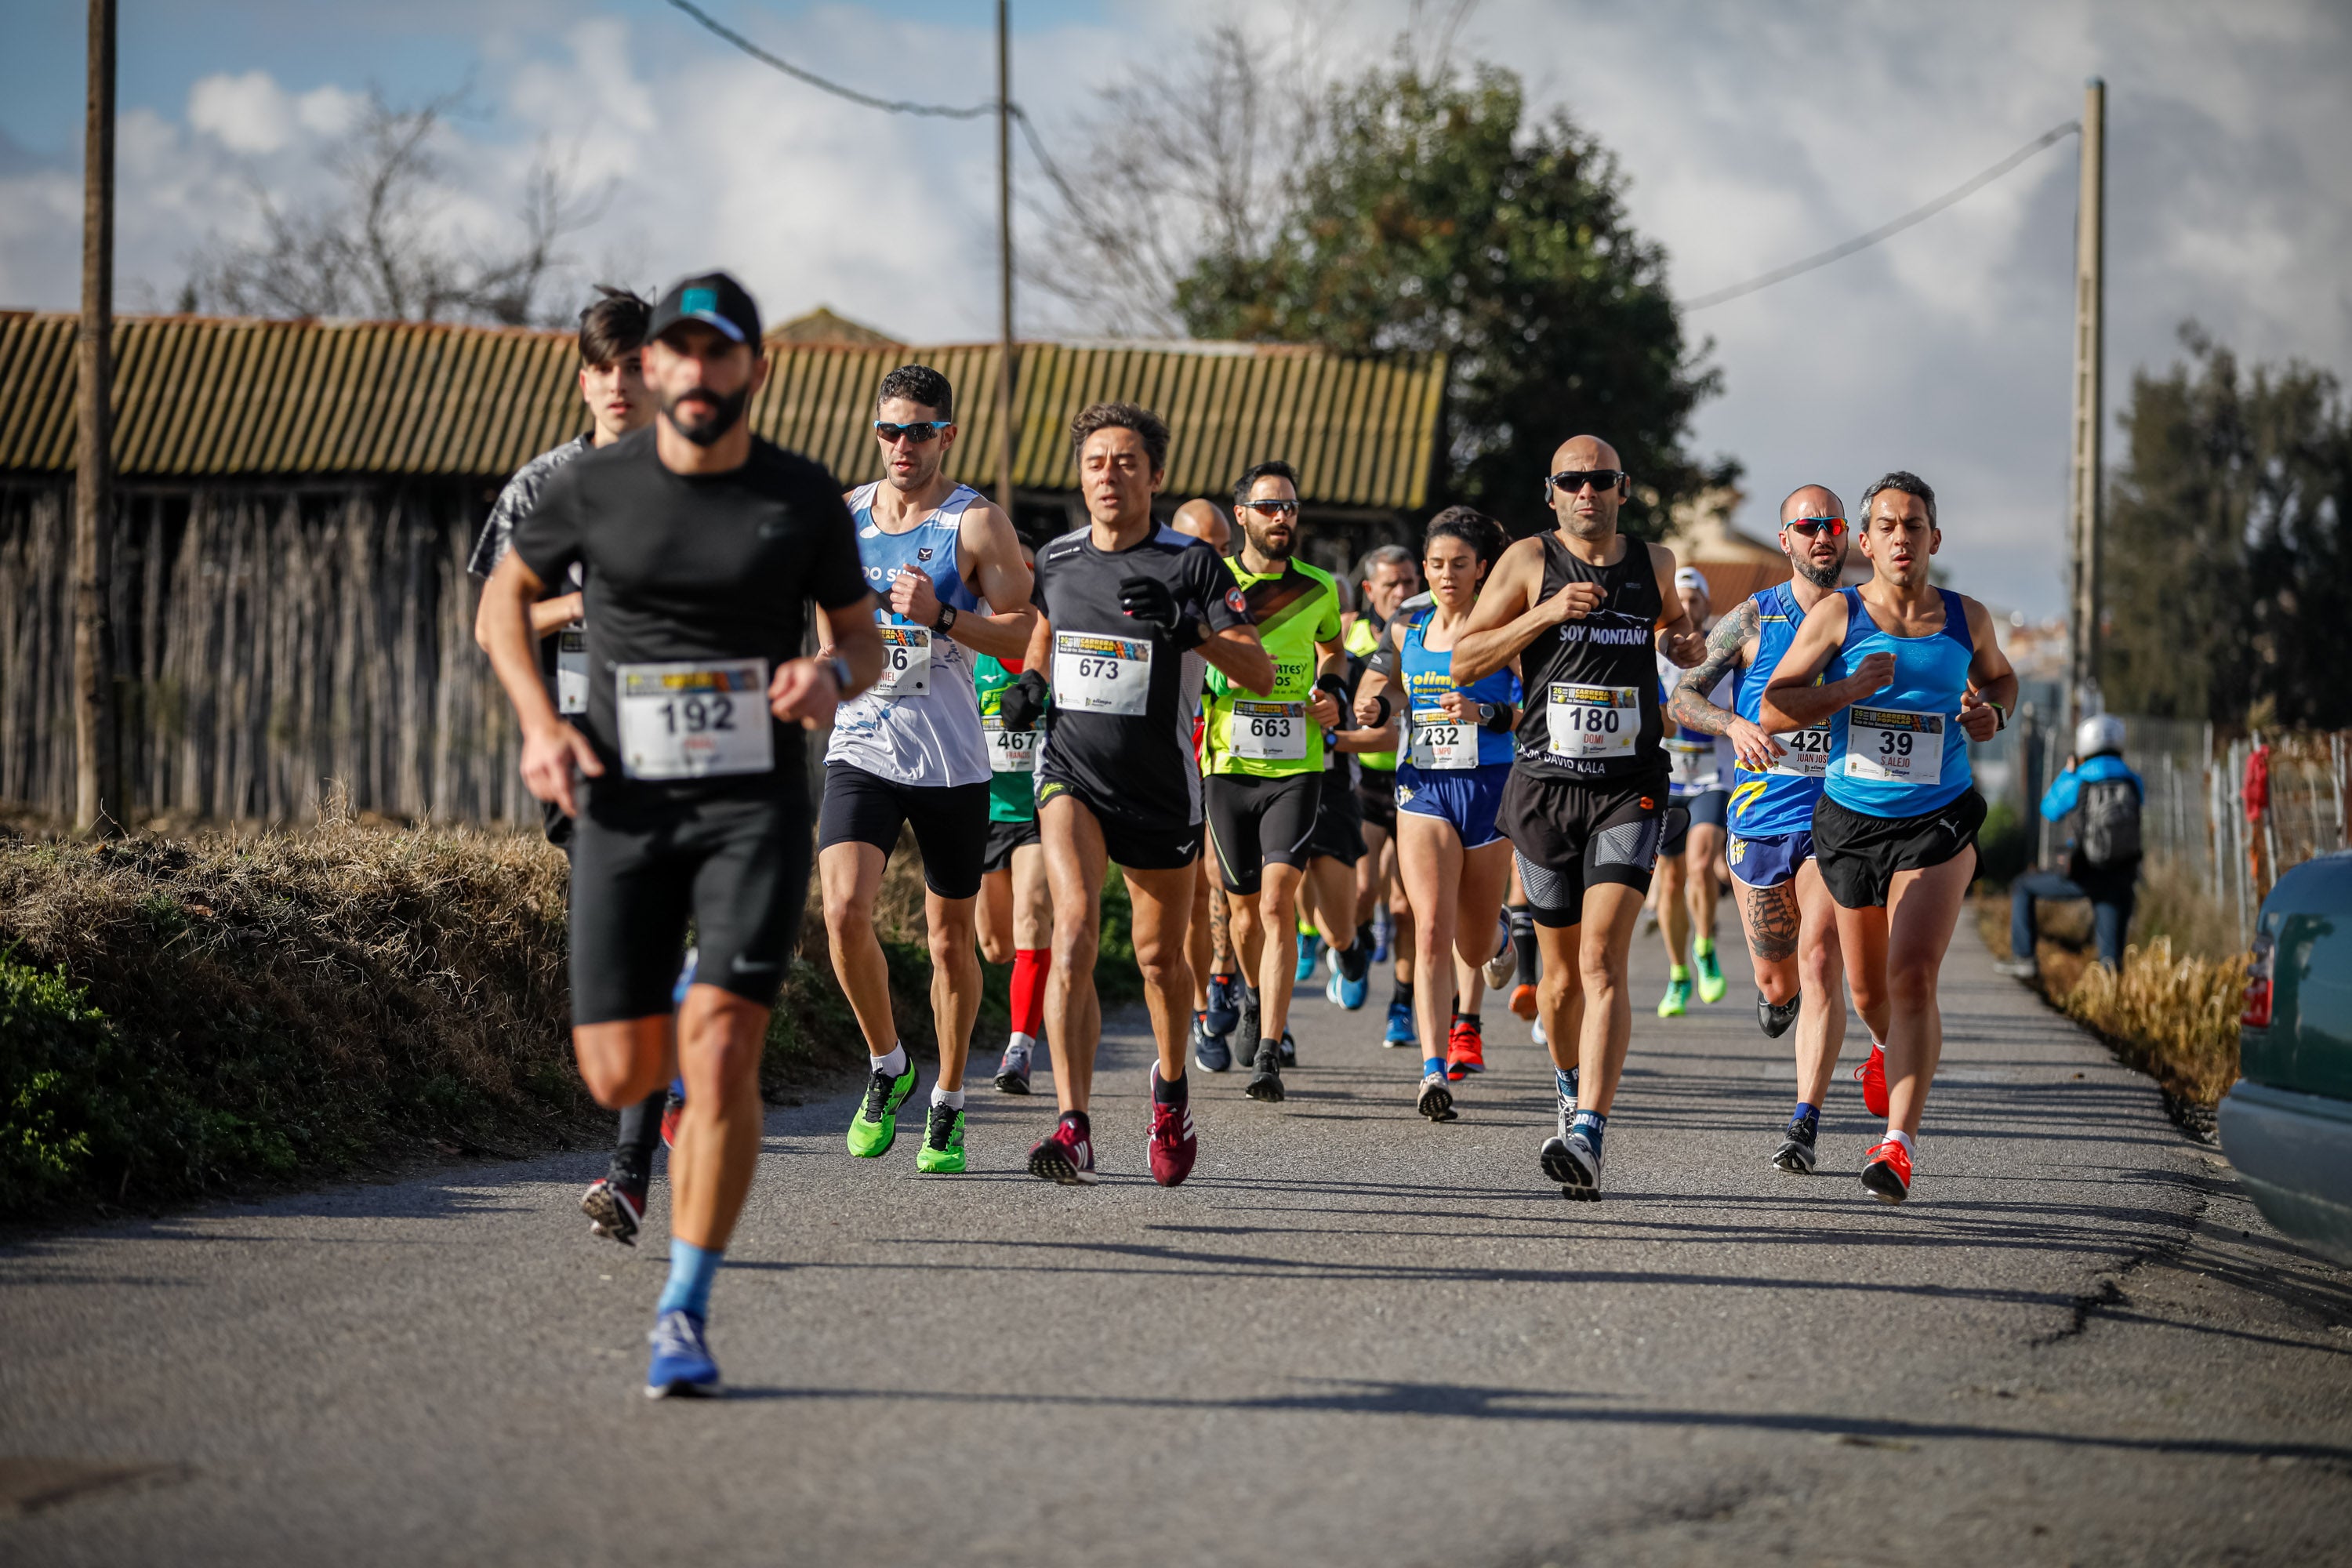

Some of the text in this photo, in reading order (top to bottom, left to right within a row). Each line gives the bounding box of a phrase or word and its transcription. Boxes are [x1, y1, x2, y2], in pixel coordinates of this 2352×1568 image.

[1560, 625, 1587, 641] SOY
[1080, 658, 1119, 680] 673
[657, 696, 735, 735] 192
[1570, 707, 1619, 733] 180
[1877, 712, 1911, 720] CARRERA
[1251, 718, 1290, 737] 663
[1425, 727, 1459, 746] 232
[997, 733, 1036, 750] 467
[1584, 734, 1604, 744] DOMI
[1790, 731, 1832, 753] 420
[1878, 731, 1913, 756] 39
[1544, 753, 1606, 774] DAVID KALA
[1797, 753, 1814, 763] JUAN
[1881, 756, 1911, 768] S.ALEJO
